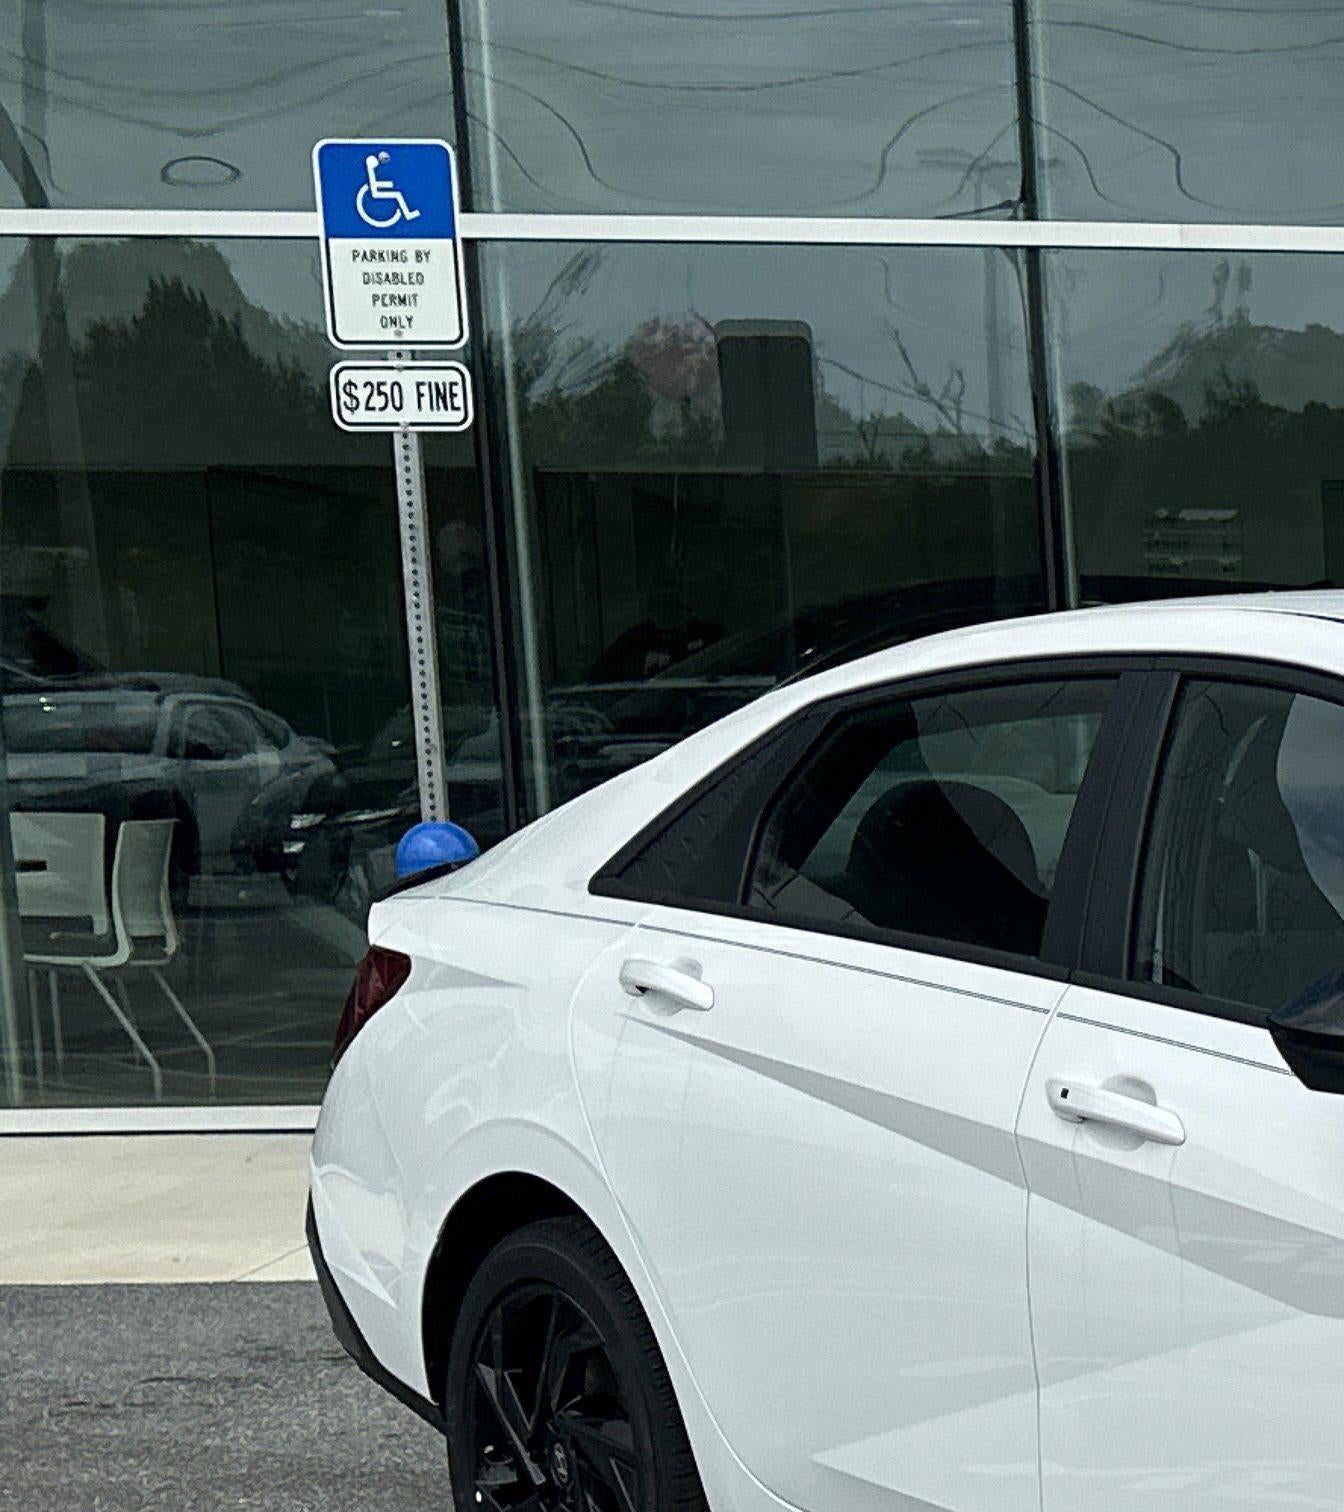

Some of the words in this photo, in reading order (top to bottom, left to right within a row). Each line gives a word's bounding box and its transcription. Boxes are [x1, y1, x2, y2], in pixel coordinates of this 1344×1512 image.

[352, 249, 409, 264] PARKING
[415, 249, 431, 264] BY
[362, 272, 425, 286] DISABLED
[371, 293, 419, 308] PERMIT
[379, 315, 414, 330] ONLY
[342, 378, 404, 415] $250
[415, 380, 462, 413] FINE
